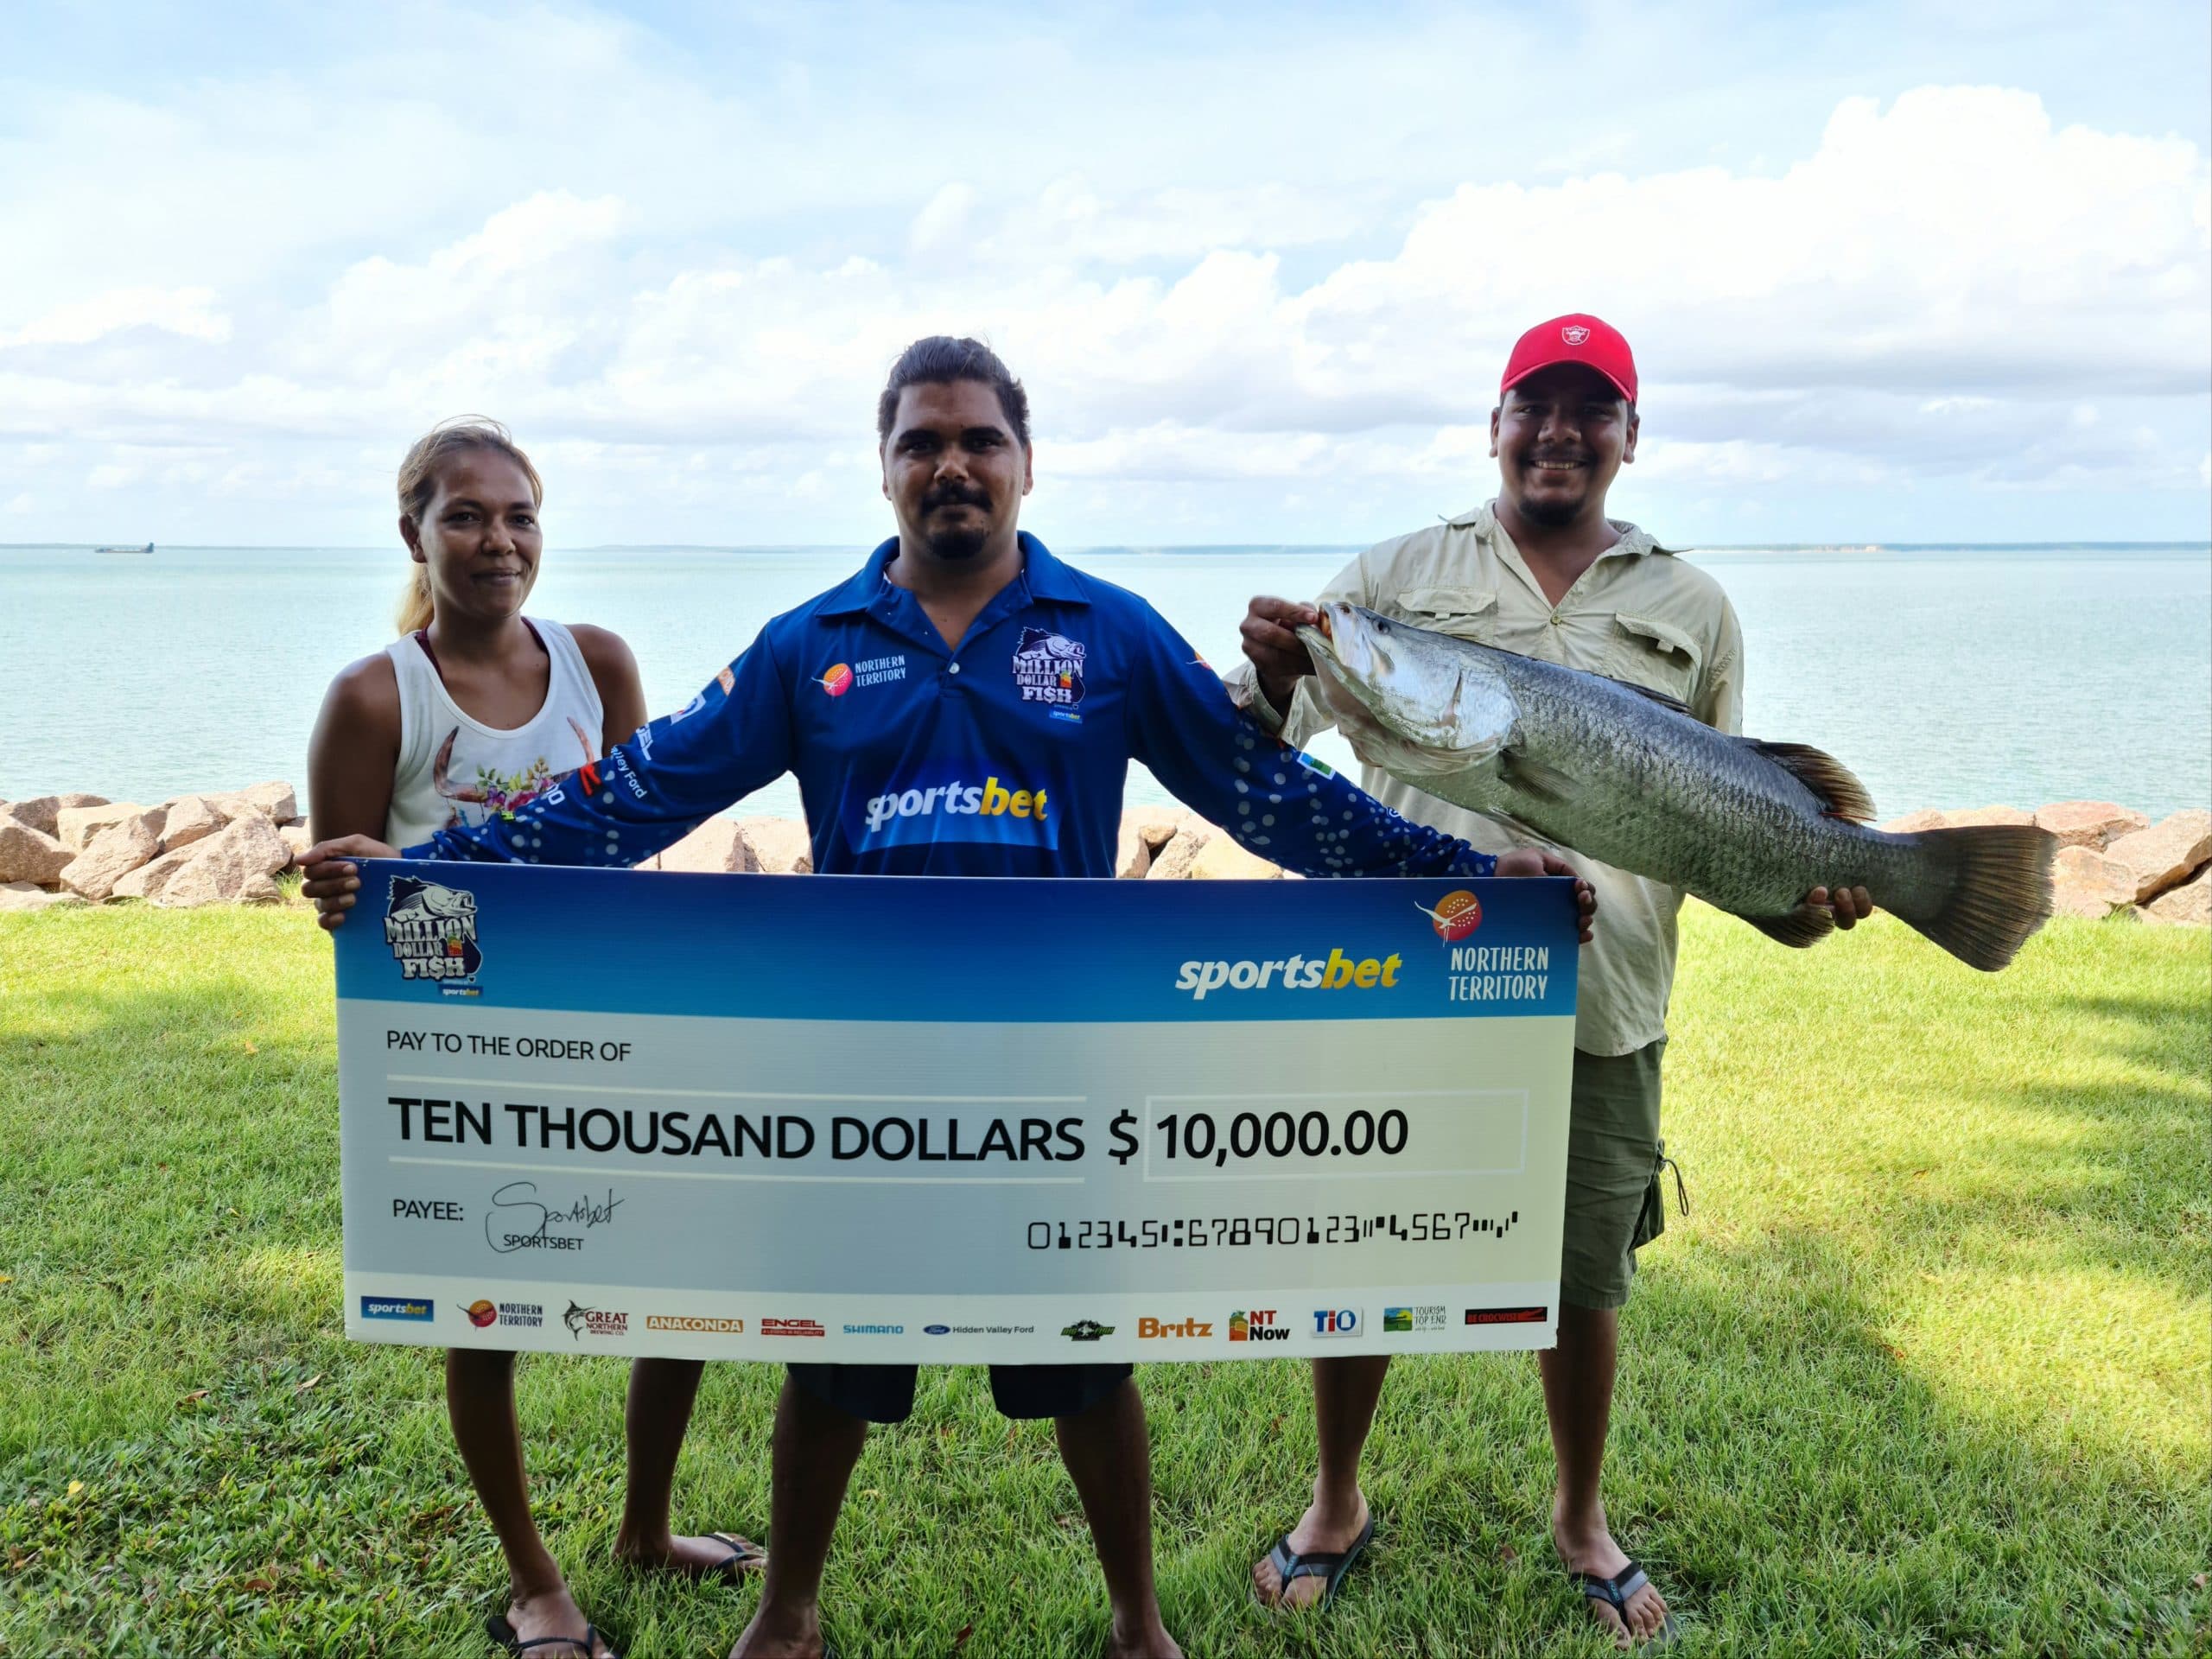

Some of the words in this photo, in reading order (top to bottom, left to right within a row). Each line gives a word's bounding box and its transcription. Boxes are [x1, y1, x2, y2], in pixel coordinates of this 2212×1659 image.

[855, 654, 906, 674] NORTHERN
[1012, 655, 1084, 678] MILLION
[855, 666, 906, 688] TERRITORY
[1016, 674, 1057, 687] DOLLAR
[624, 770, 648, 799] Ford
[865, 776, 1048, 832] sportsbet
[384, 914, 477, 943] MILLION
[392, 941, 443, 958] DOLLAR
[1450, 946, 1549, 973] NORTHERN
[1175, 948, 1403, 1001] sportsbet
[1448, 975, 1548, 1001] TERRITORY
[386, 1030, 427, 1051] PAY
[430, 1033, 462, 1053] TO
[467, 1035, 511, 1056] THE
[516, 1038, 594, 1060] ORDER
[600, 1042, 632, 1062] OF
[387, 1096, 492, 1145] TEN
[504, 1103, 816, 1160] THOUSAND
[831, 1116, 1086, 1162] DOLLARS
[1108, 1109, 1139, 1166] $
[1156, 1109, 1409, 1168] 10,000.00
[392, 1198, 464, 1221] PAYEE:
[503, 1234, 584, 1251] SPORTSBET
[367, 1303, 427, 1315] sportsbet
[499, 1303, 543, 1315] NORTHERN
[585, 1311, 629, 1324] GREAT
[1250, 1310, 1277, 1325] NT
[1414, 1306, 1446, 1316] TOURISM
[499, 1314, 543, 1328] TERRITORY
[586, 1322, 628, 1331] NORTHERN
[649, 1317, 741, 1332] ANACONDA
[761, 1319, 824, 1328] ENGEL
[1138, 1317, 1213, 1338] Britz
[1414, 1316, 1429, 1325] TOP
[842, 1325, 905, 1334] SHIMANO
[986, 1326, 1013, 1335] Valley
[1249, 1326, 1290, 1341] Now
